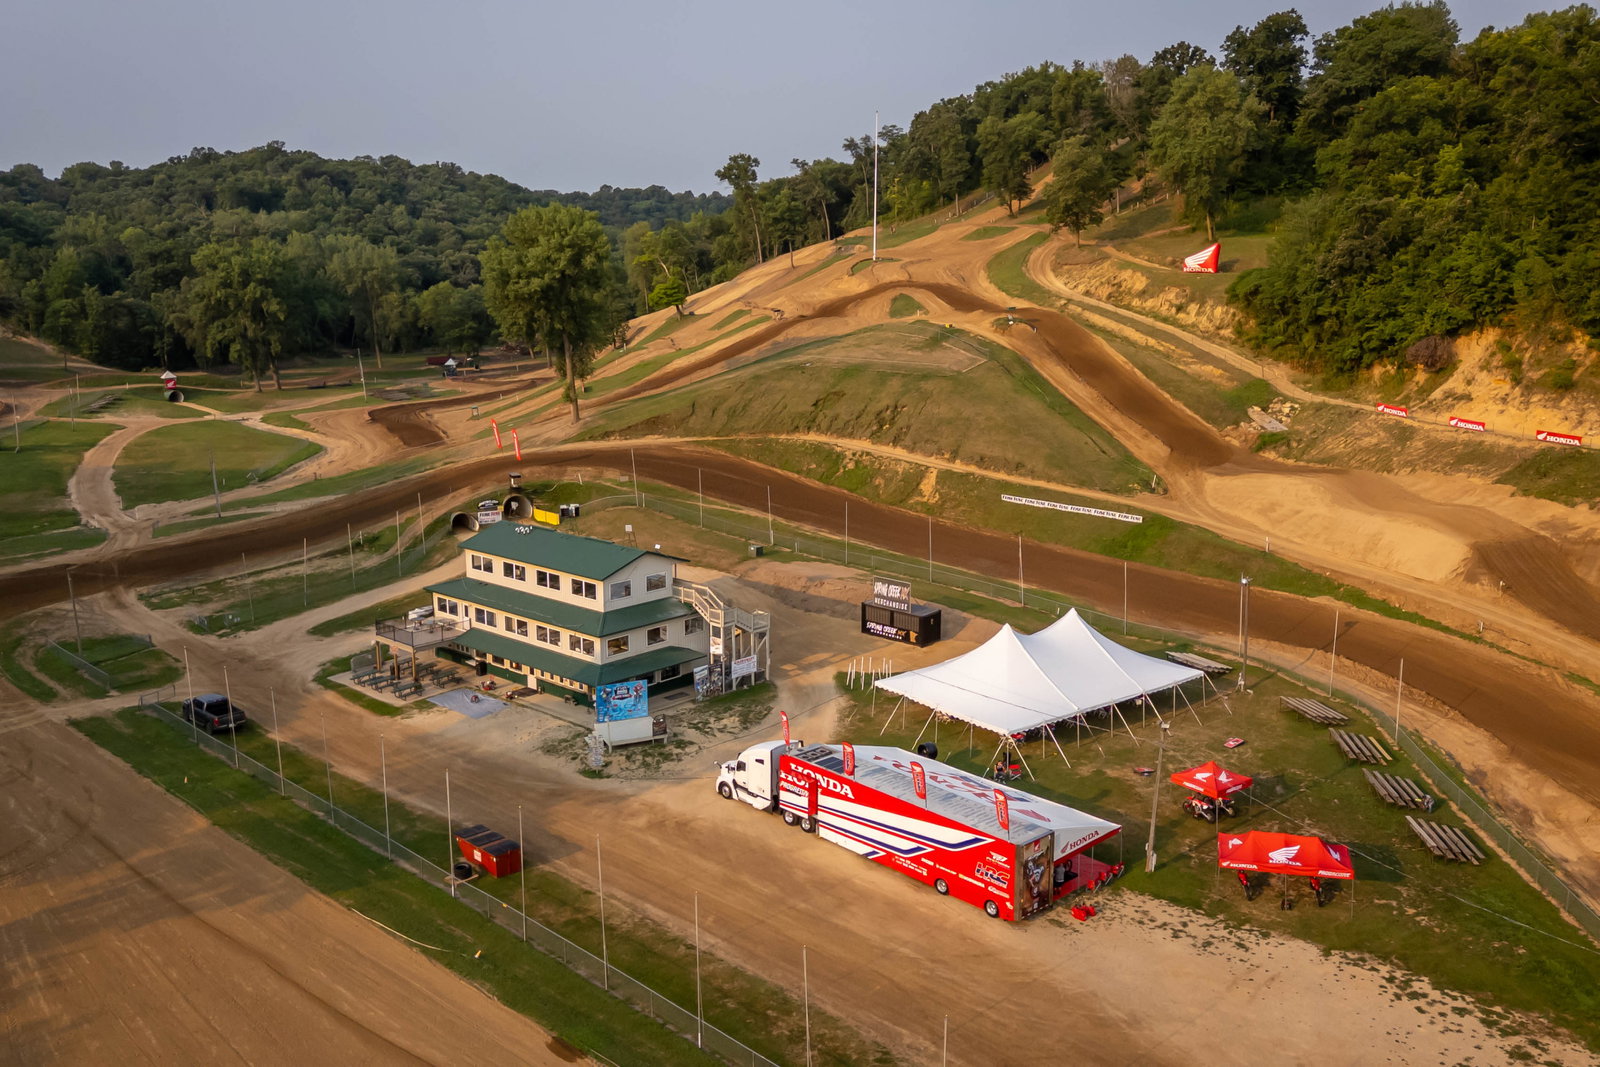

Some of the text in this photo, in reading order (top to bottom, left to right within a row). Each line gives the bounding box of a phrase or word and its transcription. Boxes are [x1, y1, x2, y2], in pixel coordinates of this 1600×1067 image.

[1383, 407, 1407, 417] HONDA
[1457, 421, 1484, 431] HONDA
[1546, 435, 1580, 446] HONDA
[874, 598, 908, 610] MERCHANDISE
[780, 763, 855, 799] HONDA
[1070, 830, 1099, 849] HONDA
[975, 862, 1010, 885] HRC
